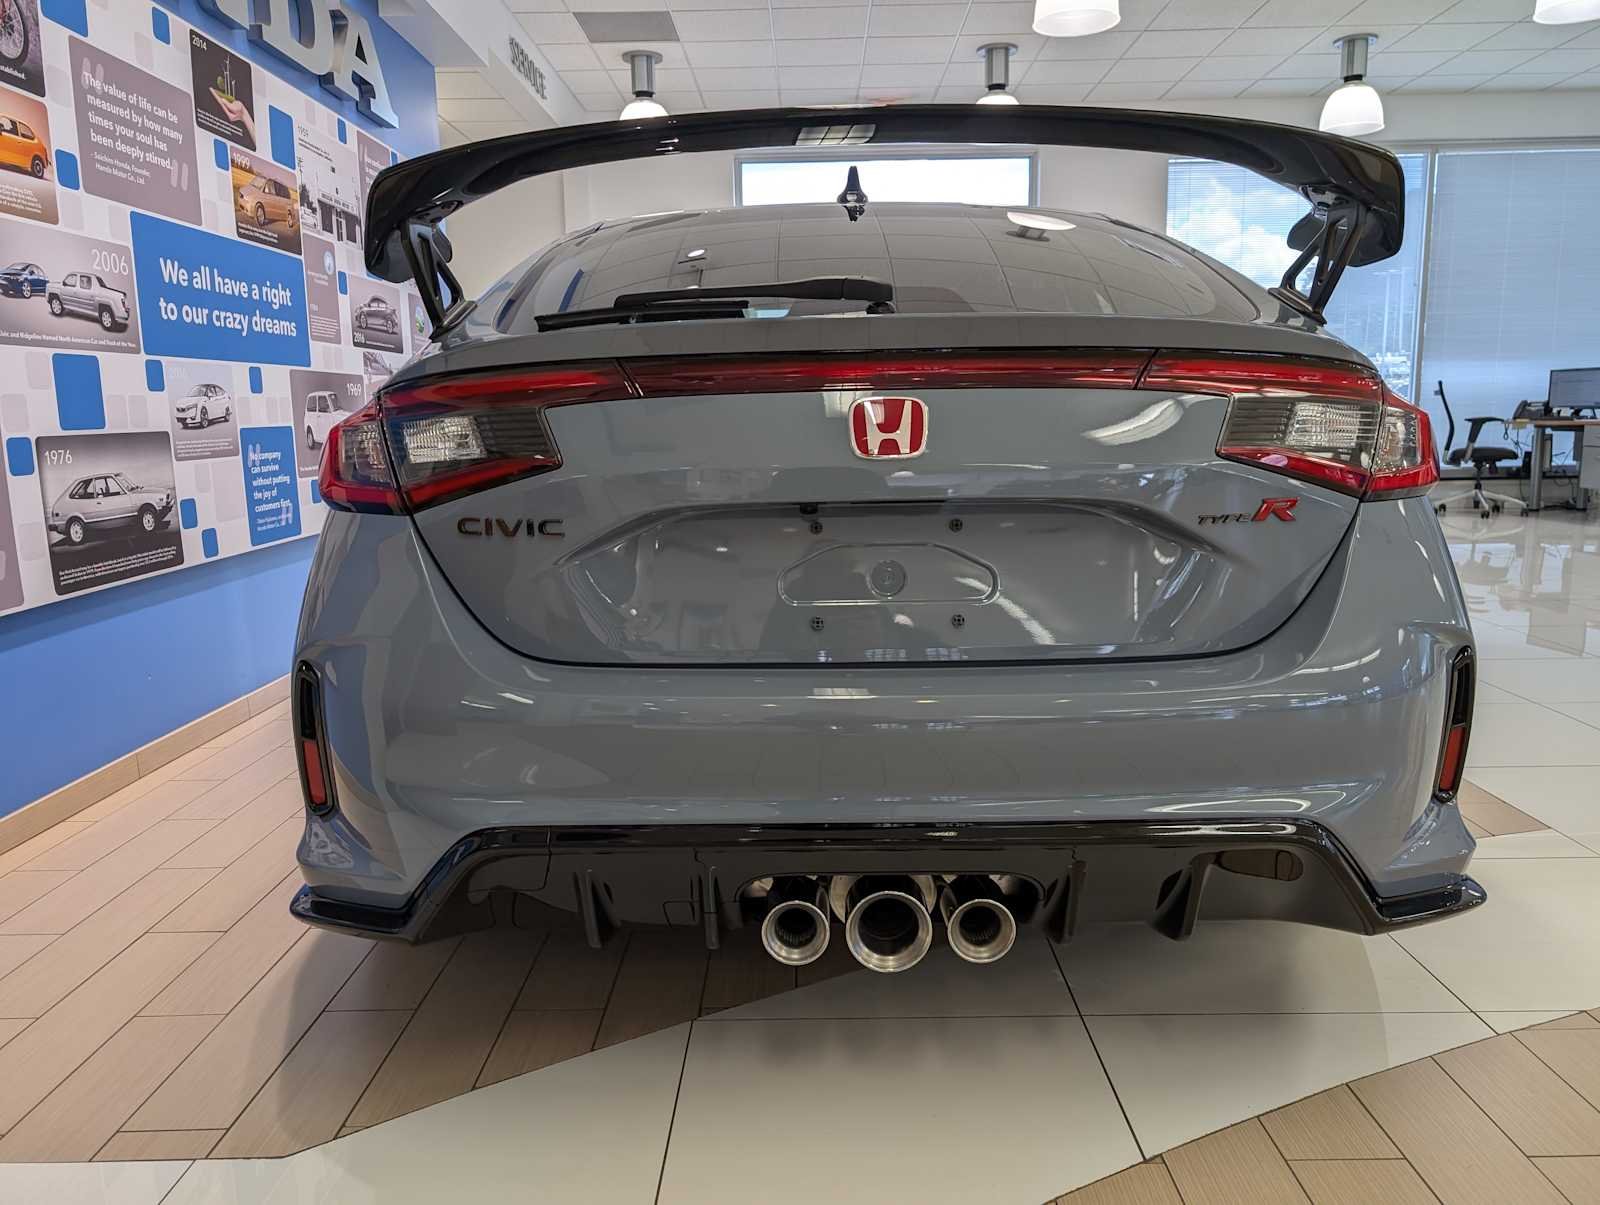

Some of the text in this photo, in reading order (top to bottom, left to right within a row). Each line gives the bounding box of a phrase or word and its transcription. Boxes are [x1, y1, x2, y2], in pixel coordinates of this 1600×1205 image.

[192, 35, 207, 51] 2014
[213, 0, 399, 129] DA
[508, 36, 548, 100] SERVICE
[83, 71, 178, 124] The value of life can be
[87, 94, 183, 144] measured by how many
[88, 112, 168, 151] times your soul has
[90, 129, 174, 170] been deeply stirred.
[233, 152, 250, 169] 1999
[91, 249, 129, 276] 2006
[160, 257, 292, 310] We all have a right
[159, 297, 178, 321] to
[181, 304, 209, 325] our
[212, 309, 249, 337] crazy
[251, 309, 297, 337] dreams
[346, 383, 362, 396] 1969
[44, 449, 73, 465] 1976
[258, 451, 281, 460] company
[251, 463, 279, 474] can survive
[252, 475, 290, 486] without putting
[253, 487, 277, 500] the joy of
[255, 502, 280, 512] customers
[1197, 497, 1300, 525] TYPE R
[457, 517, 566, 537] CIVIC
